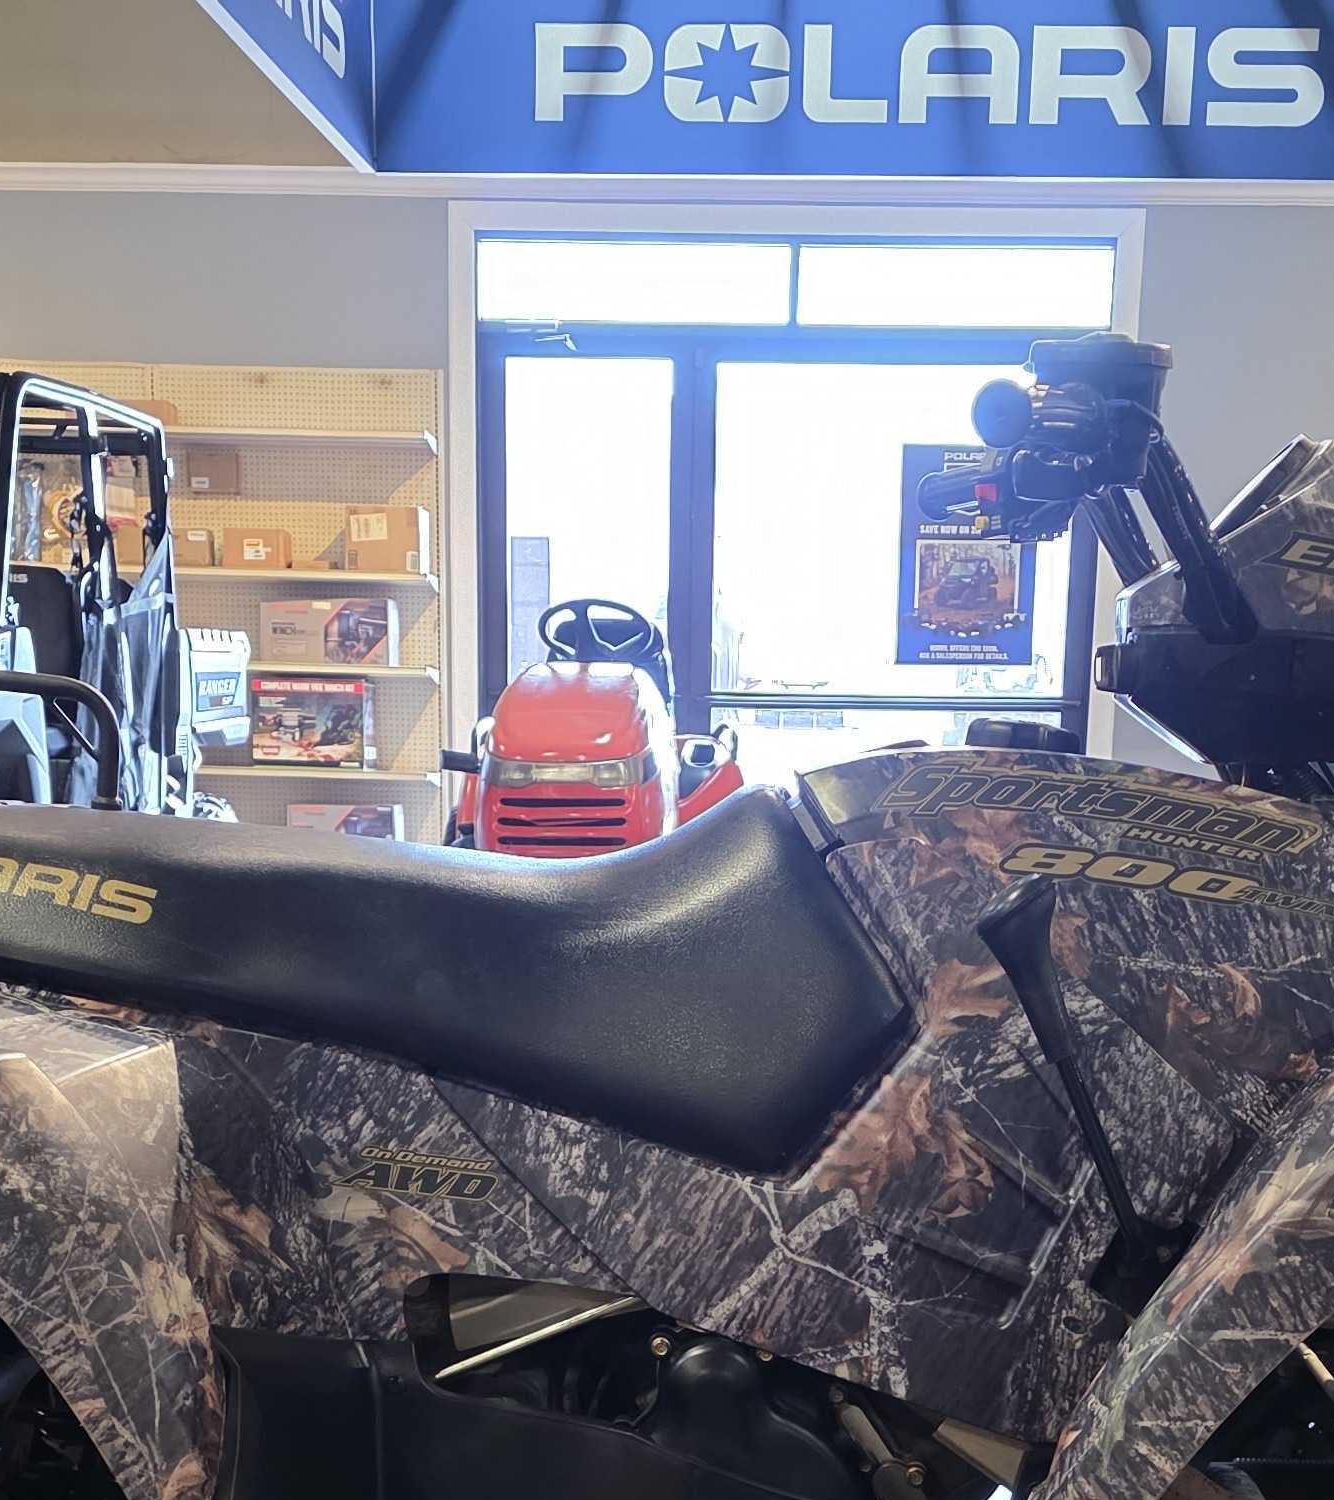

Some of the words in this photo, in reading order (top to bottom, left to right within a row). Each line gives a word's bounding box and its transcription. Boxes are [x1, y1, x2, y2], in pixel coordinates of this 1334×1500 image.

[534, 23, 1325, 128] POLARIS
[944, 452, 986, 461] POLA
[198, 679, 237, 696] RANGER
[879, 764, 1312, 852] Sportsman
[1129, 827, 1262, 861] HUNTER
[1002, 844, 1260, 902] 800
[362, 1147, 393, 1161] On
[394, 1149, 494, 1171] Demand
[334, 1162, 498, 1200] AWD
